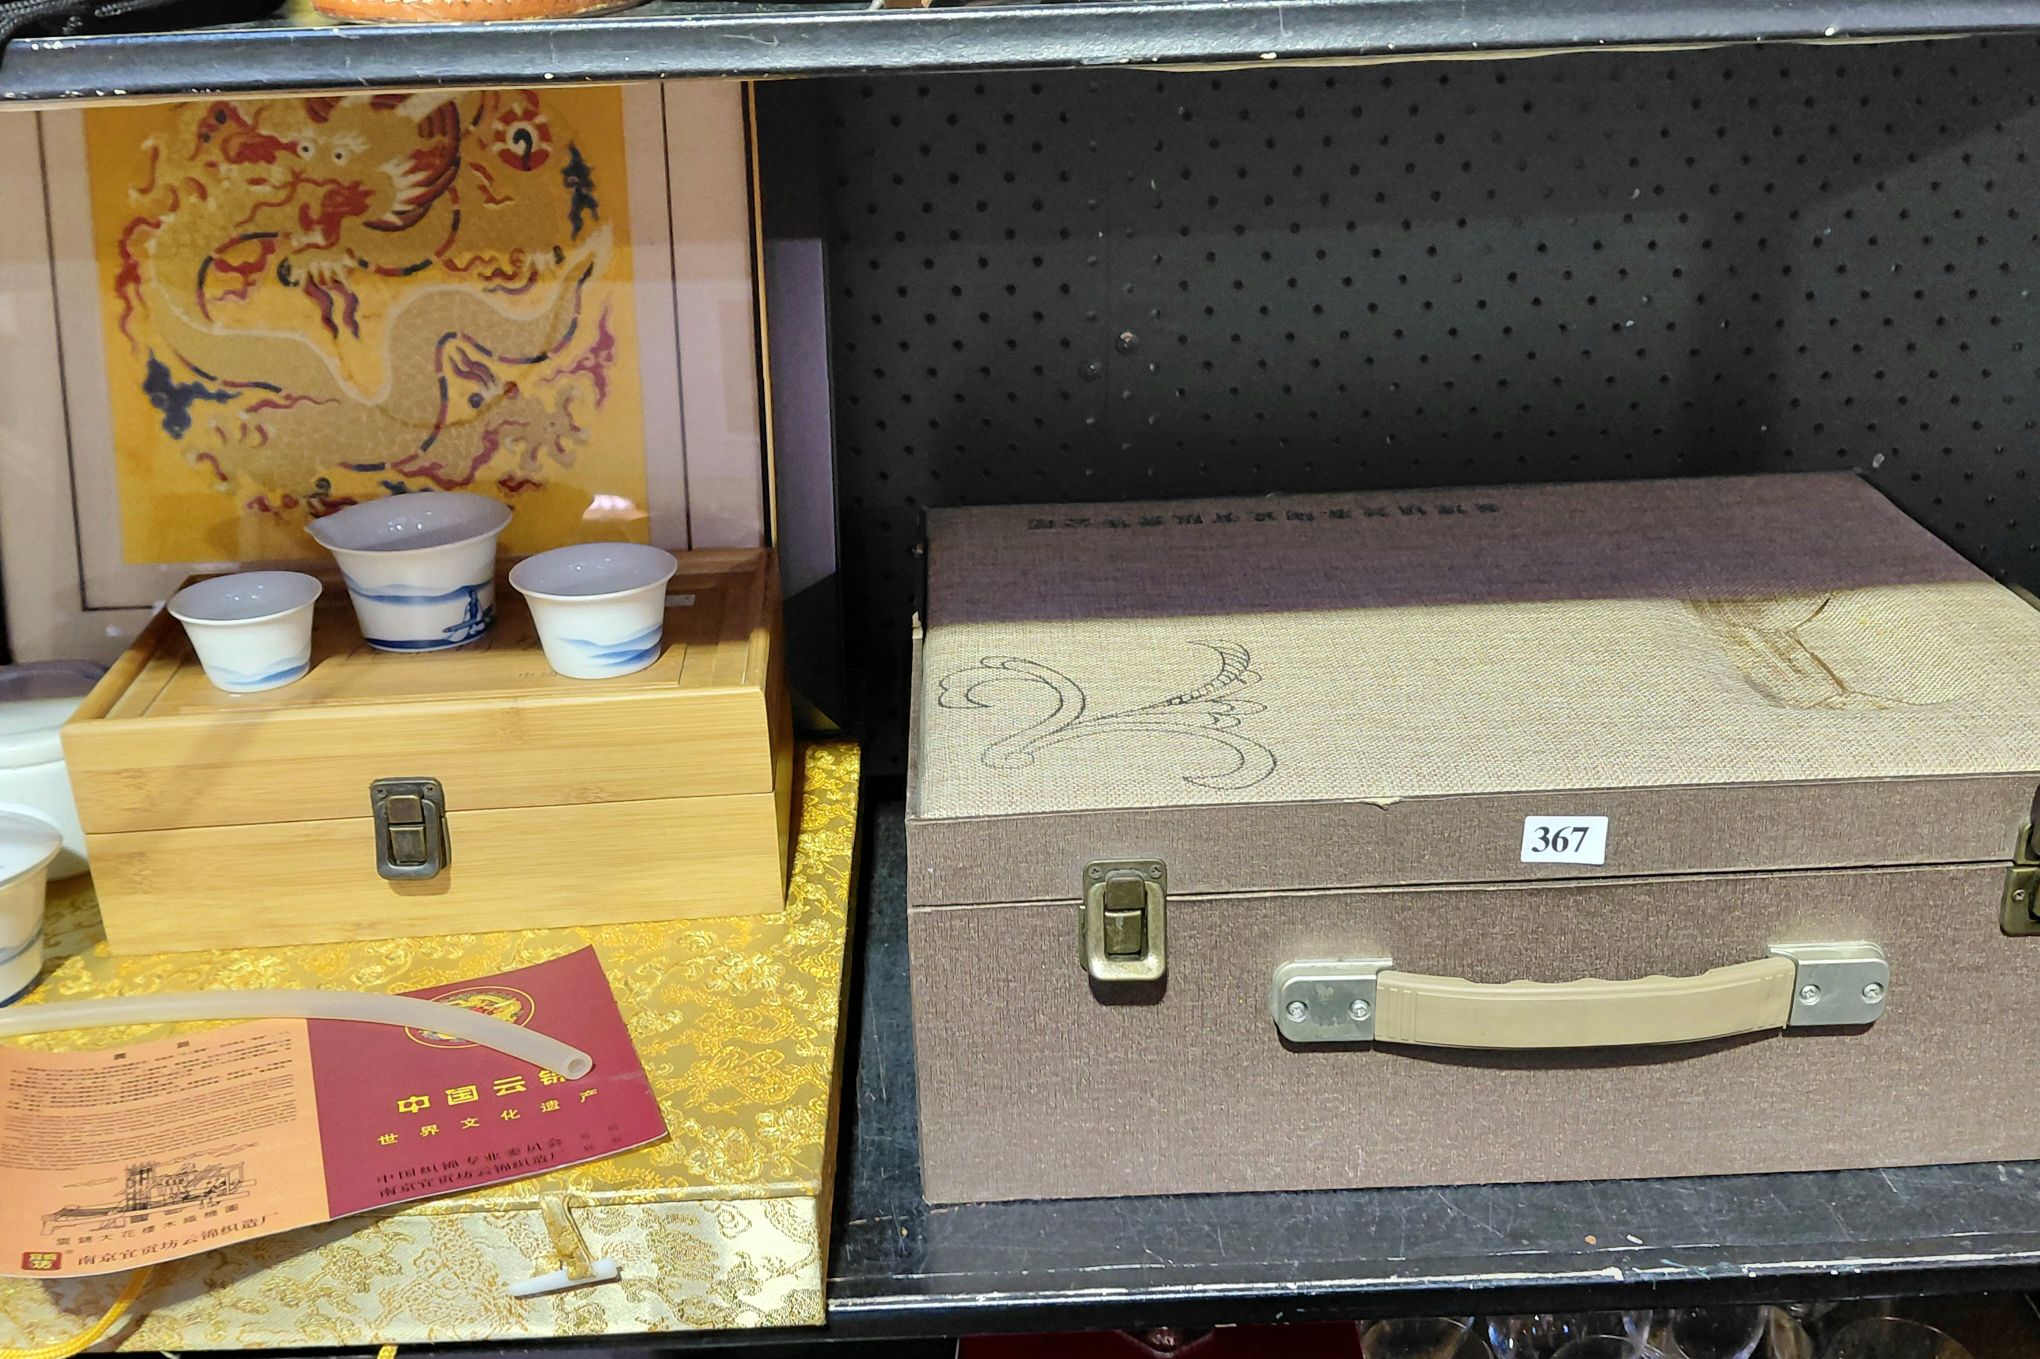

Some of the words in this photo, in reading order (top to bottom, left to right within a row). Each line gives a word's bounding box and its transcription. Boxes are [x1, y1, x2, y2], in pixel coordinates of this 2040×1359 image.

[1531, 826, 1590, 853] 367
[377, 1088, 598, 1145] 世界文化遗产
